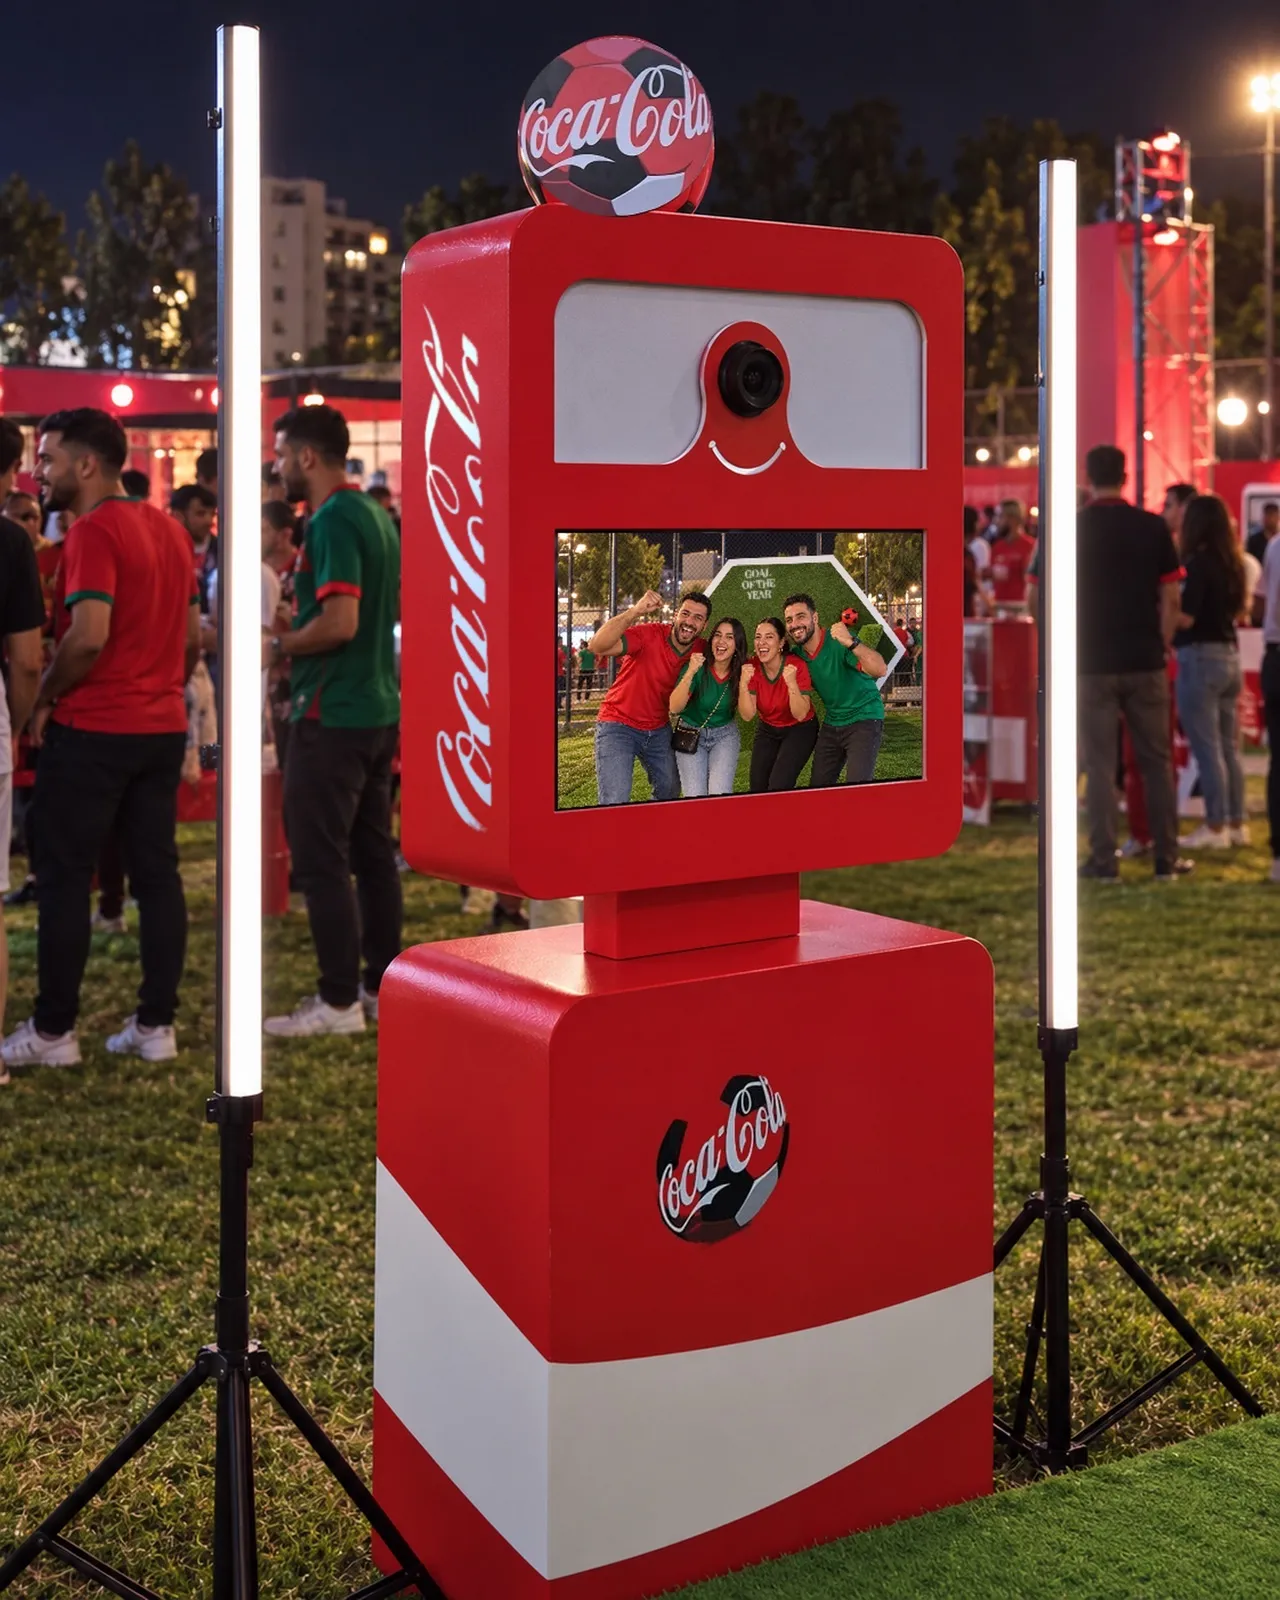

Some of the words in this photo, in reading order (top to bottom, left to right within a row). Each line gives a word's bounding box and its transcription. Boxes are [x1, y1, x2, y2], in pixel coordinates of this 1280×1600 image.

[519, 62, 711, 177] Coca-Cola
[744, 568, 772, 579] GOAL
[741, 580, 755, 590] OF
[755, 578, 776, 589] THE
[746, 590, 772, 600] YEAR
[659, 1075, 787, 1233] Coca-Cola
